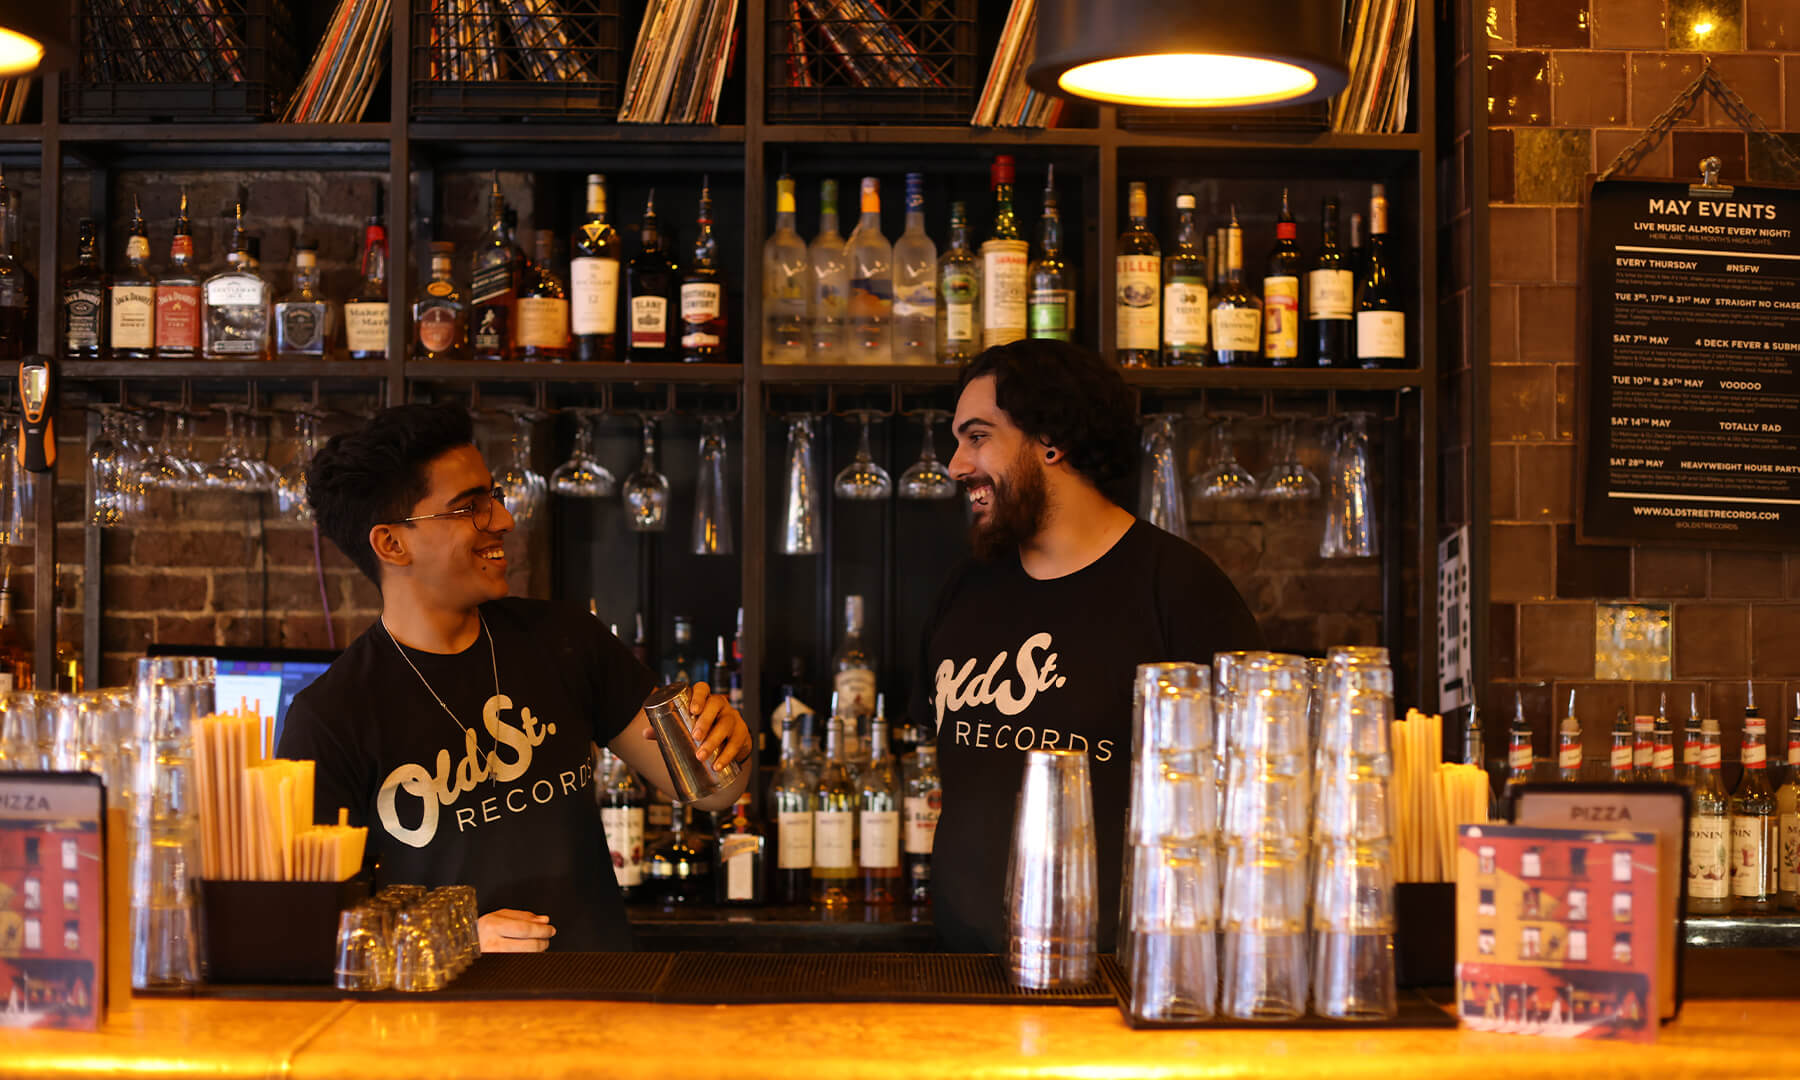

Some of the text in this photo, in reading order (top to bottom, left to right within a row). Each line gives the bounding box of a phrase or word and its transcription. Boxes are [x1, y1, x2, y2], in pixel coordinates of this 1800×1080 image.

[1649, 199, 1777, 220] MAY EVENTS
[1634, 222, 1791, 238] LIVE MUSIC ALMOST EVERY NIGHT!
[1616, 258, 1698, 270] EVERY THURSDAY
[1726, 264, 1760, 273] #NSFW
[1615, 292, 1632, 301] TUE
[1693, 297, 1711, 305] MAY
[1715, 298, 1757, 307] STRAIGHT
[1759, 300, 1772, 308] NO
[1613, 335, 1631, 343] SAT
[1649, 336, 1669, 345] MAY
[1695, 339, 1702, 347] 4
[1704, 339, 1729, 348] DECK
[1732, 340, 1762, 349] FEVER
[1763, 342, 1770, 350] &
[1612, 376, 1630, 385] TUE
[1653, 378, 1660, 386] &
[1684, 379, 1704, 388] MAY
[1720, 380, 1762, 391] VOODOO
[1611, 417, 1628, 426] SAT
[1651, 419, 1671, 428] MAY
[1719, 422, 1782, 433] TOTALLY RAD
[1610, 458, 1626, 467] SAT
[1646, 460, 1664, 468] MAY
[1680, 461, 1742, 472] HEAVYWEIGHT
[1744, 463, 1773, 473] HOUSE
[1633, 506, 1780, 521] WWW.OLDSTREETRECORDS.COM
[955, 720, 1115, 762] RECORDS
[456, 756, 592, 833] RECORDS
[0, 794, 50, 811] IZZA
[1571, 806, 1632, 822] PIZZA
